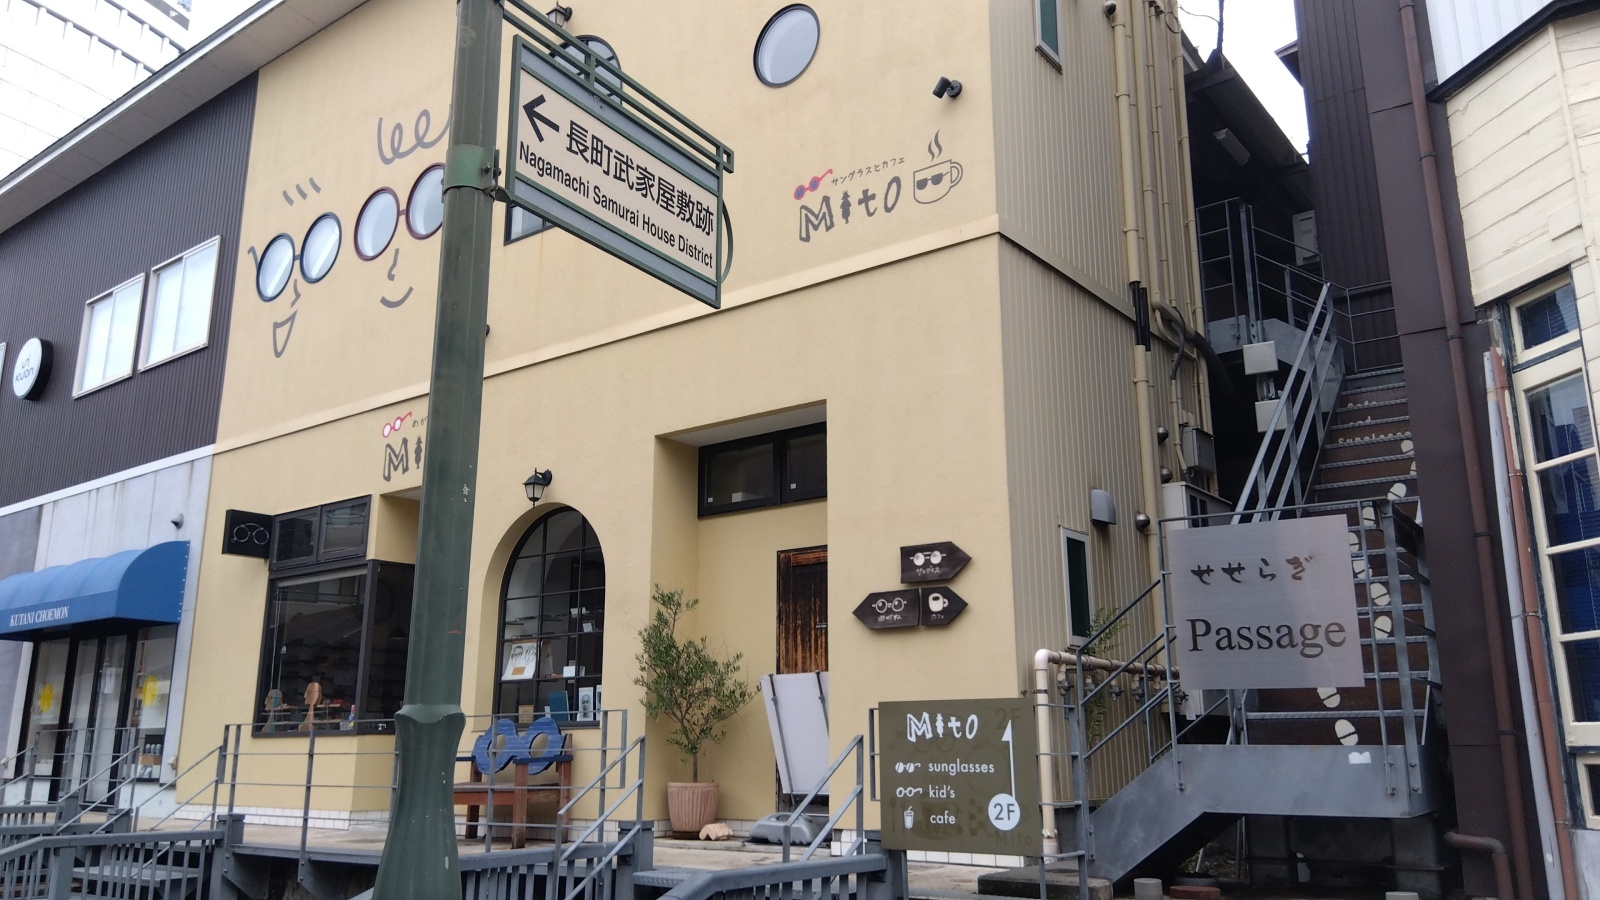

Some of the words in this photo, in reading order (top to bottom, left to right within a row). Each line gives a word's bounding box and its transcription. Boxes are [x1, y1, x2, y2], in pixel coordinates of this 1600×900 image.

[566, 119, 715, 237] 長町武家屋敷跡
[831, 157, 905, 186] サングラスとカフェ
[519, 140, 590, 199] Nagamachi
[592, 185, 640, 228] Samurai
[642, 213, 675, 248] House
[678, 234, 713, 269] District
[1190, 556, 1313, 586] せせらぎ
[10, 611, 35, 627] KUTANI
[35, 605, 70, 623] CHOEMON
[1186, 617, 1347, 659] Passage
[928, 758, 995, 776] sunglasses
[928, 784, 956, 799] kid's
[929, 810, 957, 825] cafe
[993, 802, 1016, 821] 2F
